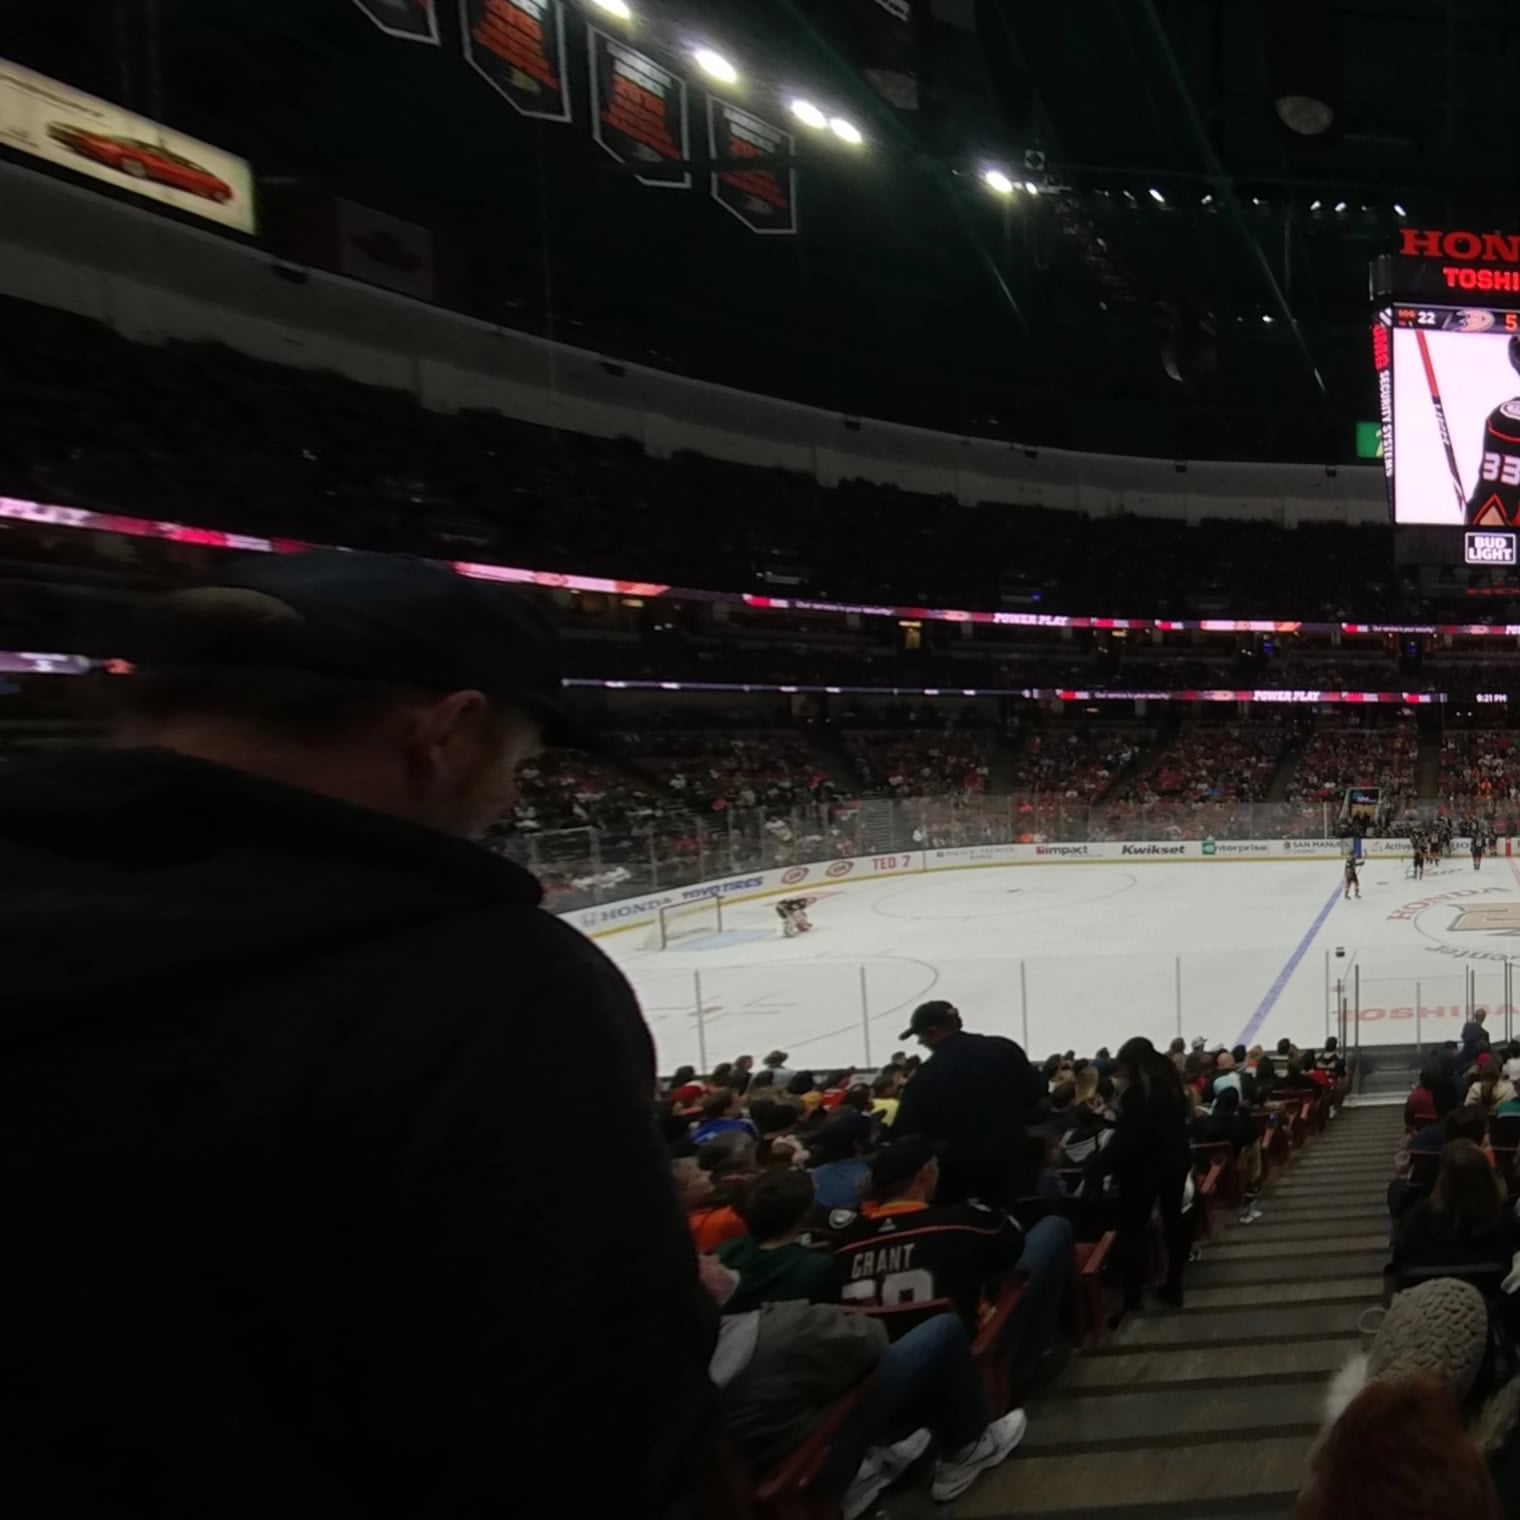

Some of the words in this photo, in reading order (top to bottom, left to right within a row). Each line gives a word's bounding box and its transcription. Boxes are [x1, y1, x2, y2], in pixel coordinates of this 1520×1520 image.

[1418, 311, 1436, 325] 22
[1504, 313, 1518, 332] 5
[1379, 370, 1392, 423] SECURITY
[1383, 424, 1393, 478] SYSTEMS
[1474, 536, 1507, 550] BUD
[1468, 547, 1514, 561] LIGHT
[992, 611, 1037, 625] POWER
[1038, 613, 1069, 627] PLAY
[1252, 690, 1292, 702] POWER
[1292, 690, 1320, 702] PLAY
[1476, 693, 1492, 703] 9:21
[1493, 693, 1508, 703] PM
[1045, 845, 1088, 856] impact
[1121, 844, 1186, 856] Kwikset
[1293, 841, 1311, 849] SAN
[872, 857, 898, 872] TED
[680, 885, 722, 900] TOYO
[722, 875, 764, 893] TIRES
[601, 897, 673, 921] HONDA
[1386, 886, 1512, 922] HONDA
[850, 1242, 917, 1281] GRANT
